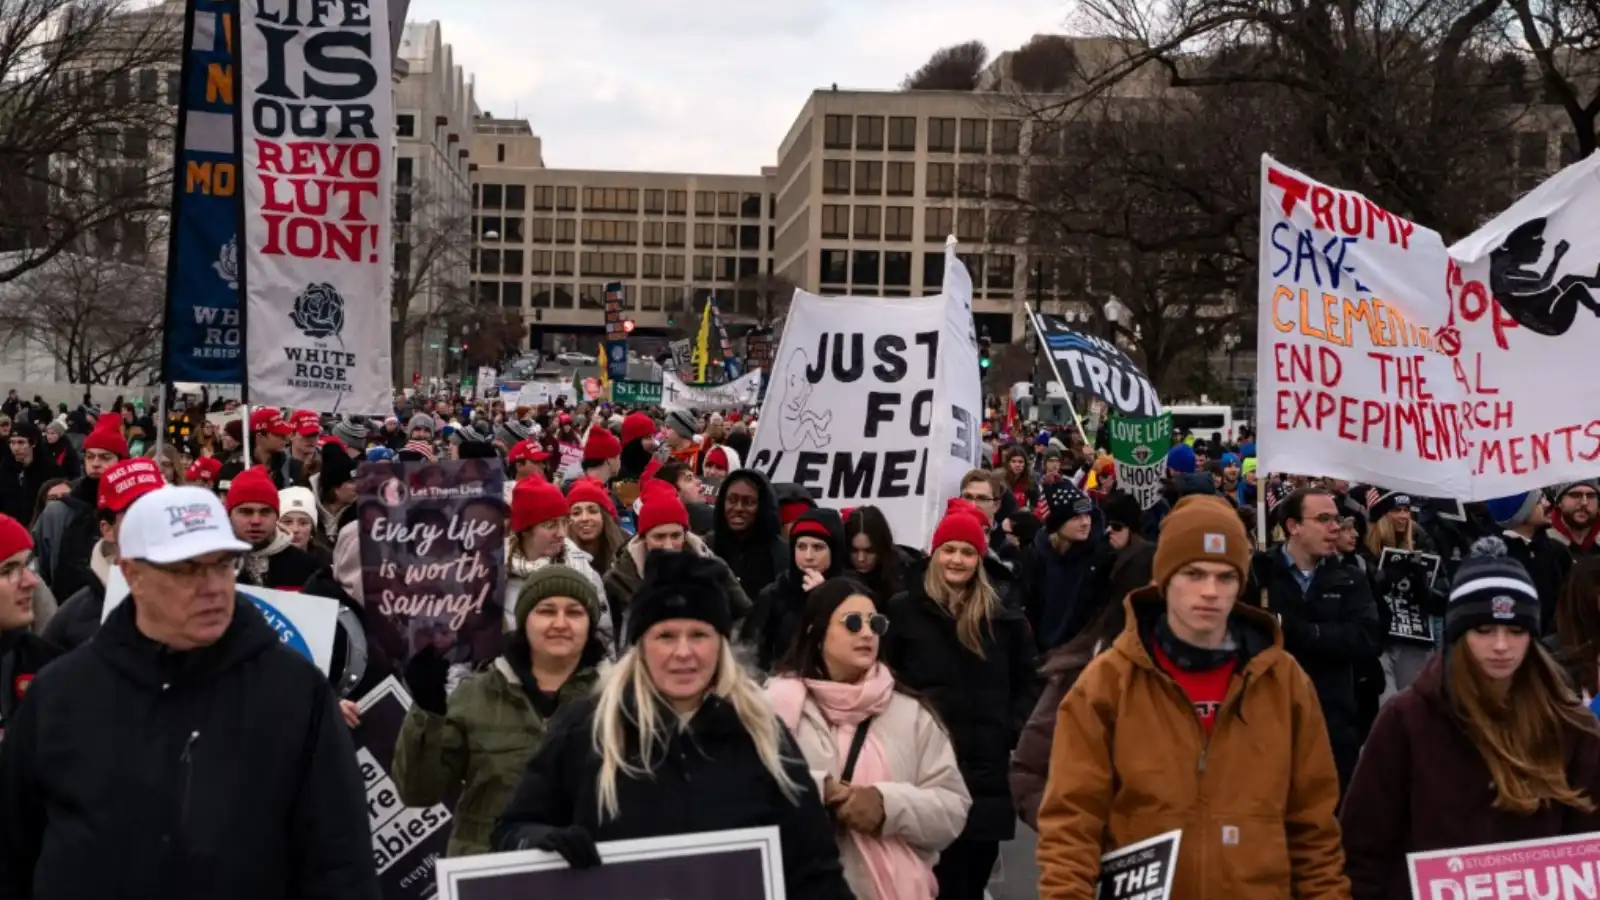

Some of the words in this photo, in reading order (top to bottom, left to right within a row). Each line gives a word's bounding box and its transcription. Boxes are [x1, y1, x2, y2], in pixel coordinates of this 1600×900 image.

[256, 0, 372, 27] LIFE
[254, 23, 378, 101] IS
[206, 63, 233, 105] N
[252, 98, 379, 139] OUR
[254, 138, 381, 179] REVO
[258, 174, 378, 221] LUT
[1267, 166, 1414, 250] TRUMP
[260, 213, 379, 263] ION!
[1271, 222, 1372, 292] SAVE
[193, 347, 240, 358] RESIS
[283, 346, 356, 367] WHITE
[295, 363, 347, 382] ROSE
[805, 330, 939, 384] JUST
[1275, 343, 1342, 388] END
[1367, 352, 1434, 400] THE
[287, 378, 353, 393] RESISTANCE
[1111, 419, 1143, 443] LOVE
[1146, 416, 1170, 442] LIFE
[1478, 421, 1600, 475] MENTS
[411, 488, 428, 496] Let
[430, 486, 459, 495] Them
[460, 484, 484, 494] Live
[1120, 464, 1164, 487] CHOOS
[371, 516, 444, 556] Every
[380, 558, 397, 579] is
[405, 550, 489, 585] worth
[256, 604, 294, 643] HTS
[1113, 861, 1162, 897] THE
[1429, 860, 1600, 900] DEFUN
